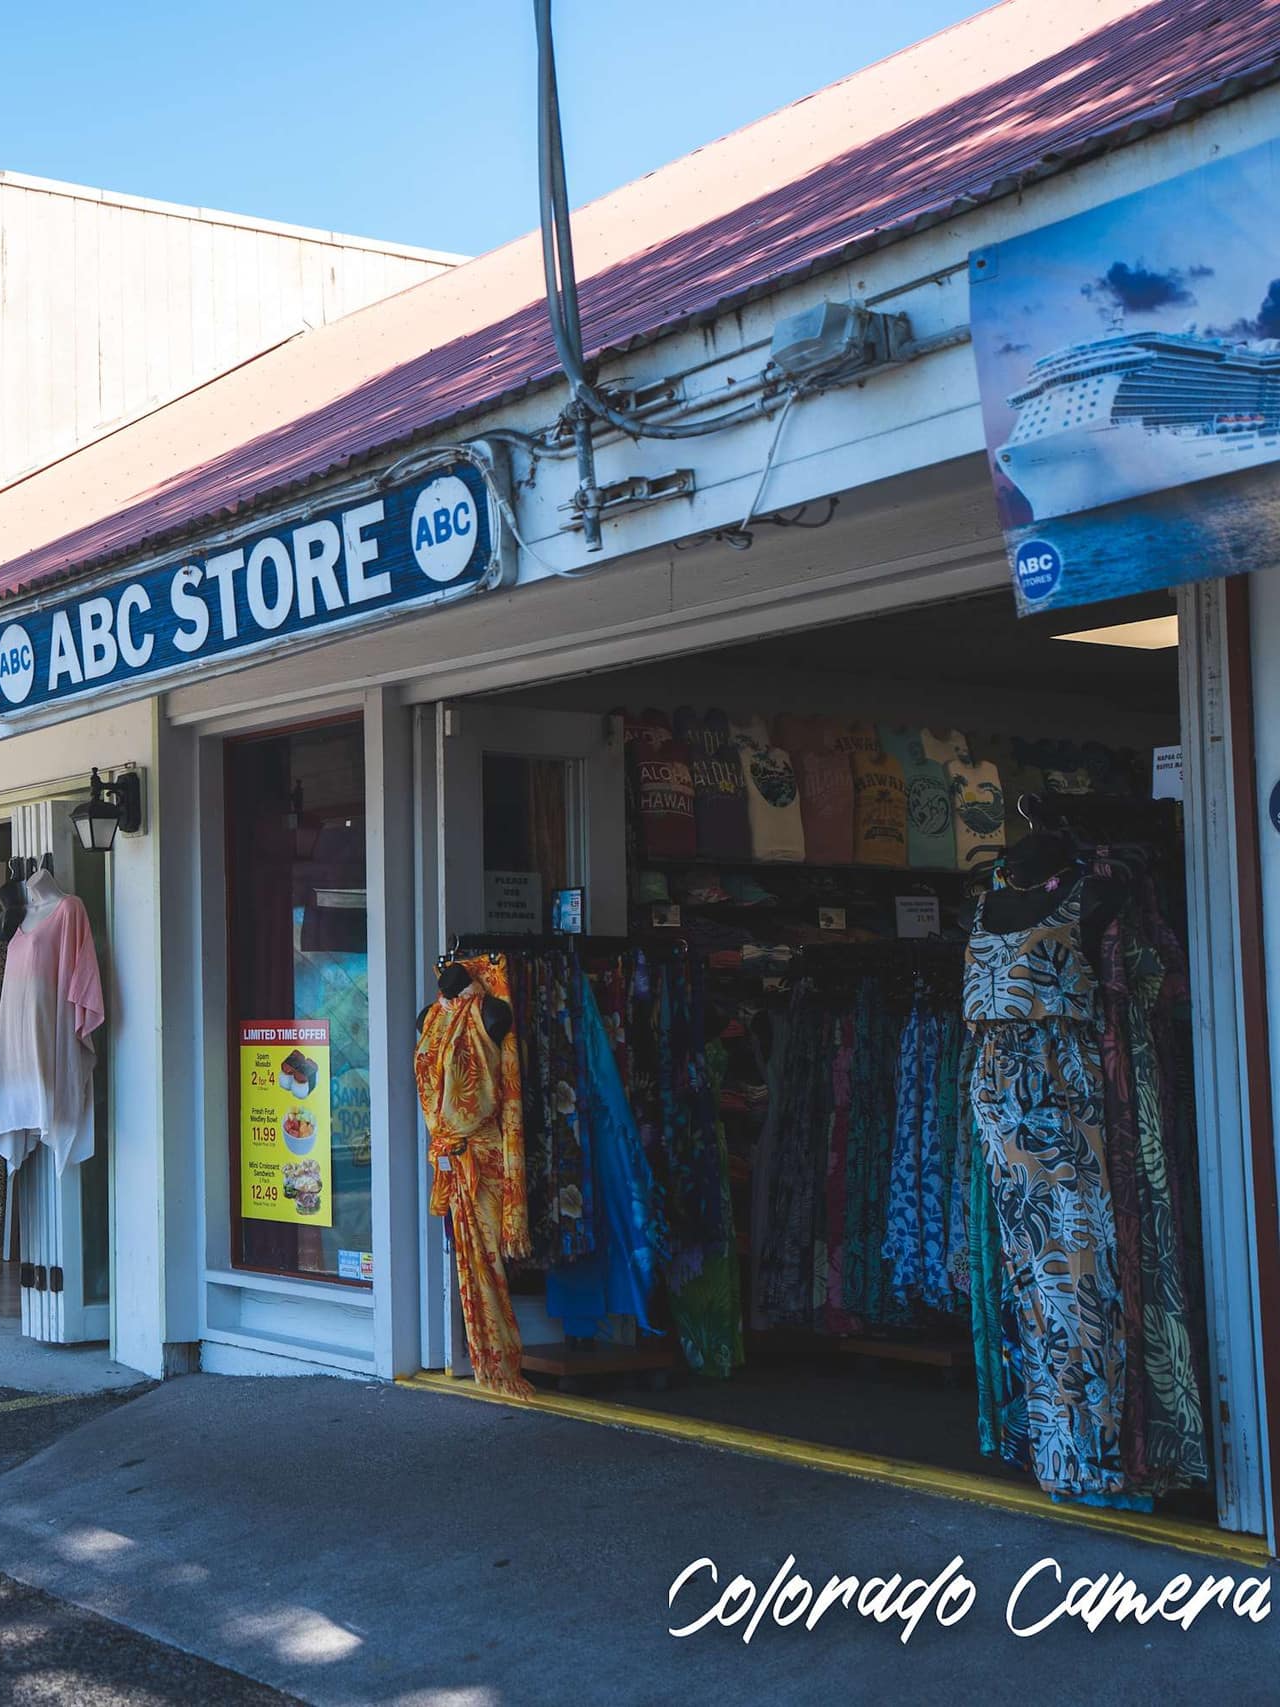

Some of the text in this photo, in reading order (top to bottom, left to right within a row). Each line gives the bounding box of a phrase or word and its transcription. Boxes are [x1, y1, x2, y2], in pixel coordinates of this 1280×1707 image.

[414, 501, 471, 552] ABC
[1019, 553, 1053, 576] ABC
[48, 499, 392, 691] ABC STORE
[0, 644, 32, 678] ABC
[243, 1028, 327, 1041] LIMITED TIME OFFER
[251, 1071, 258, 1086] 2
[252, 1127, 276, 1142] 11.99
[251, 1185, 278, 1201] 12.49
